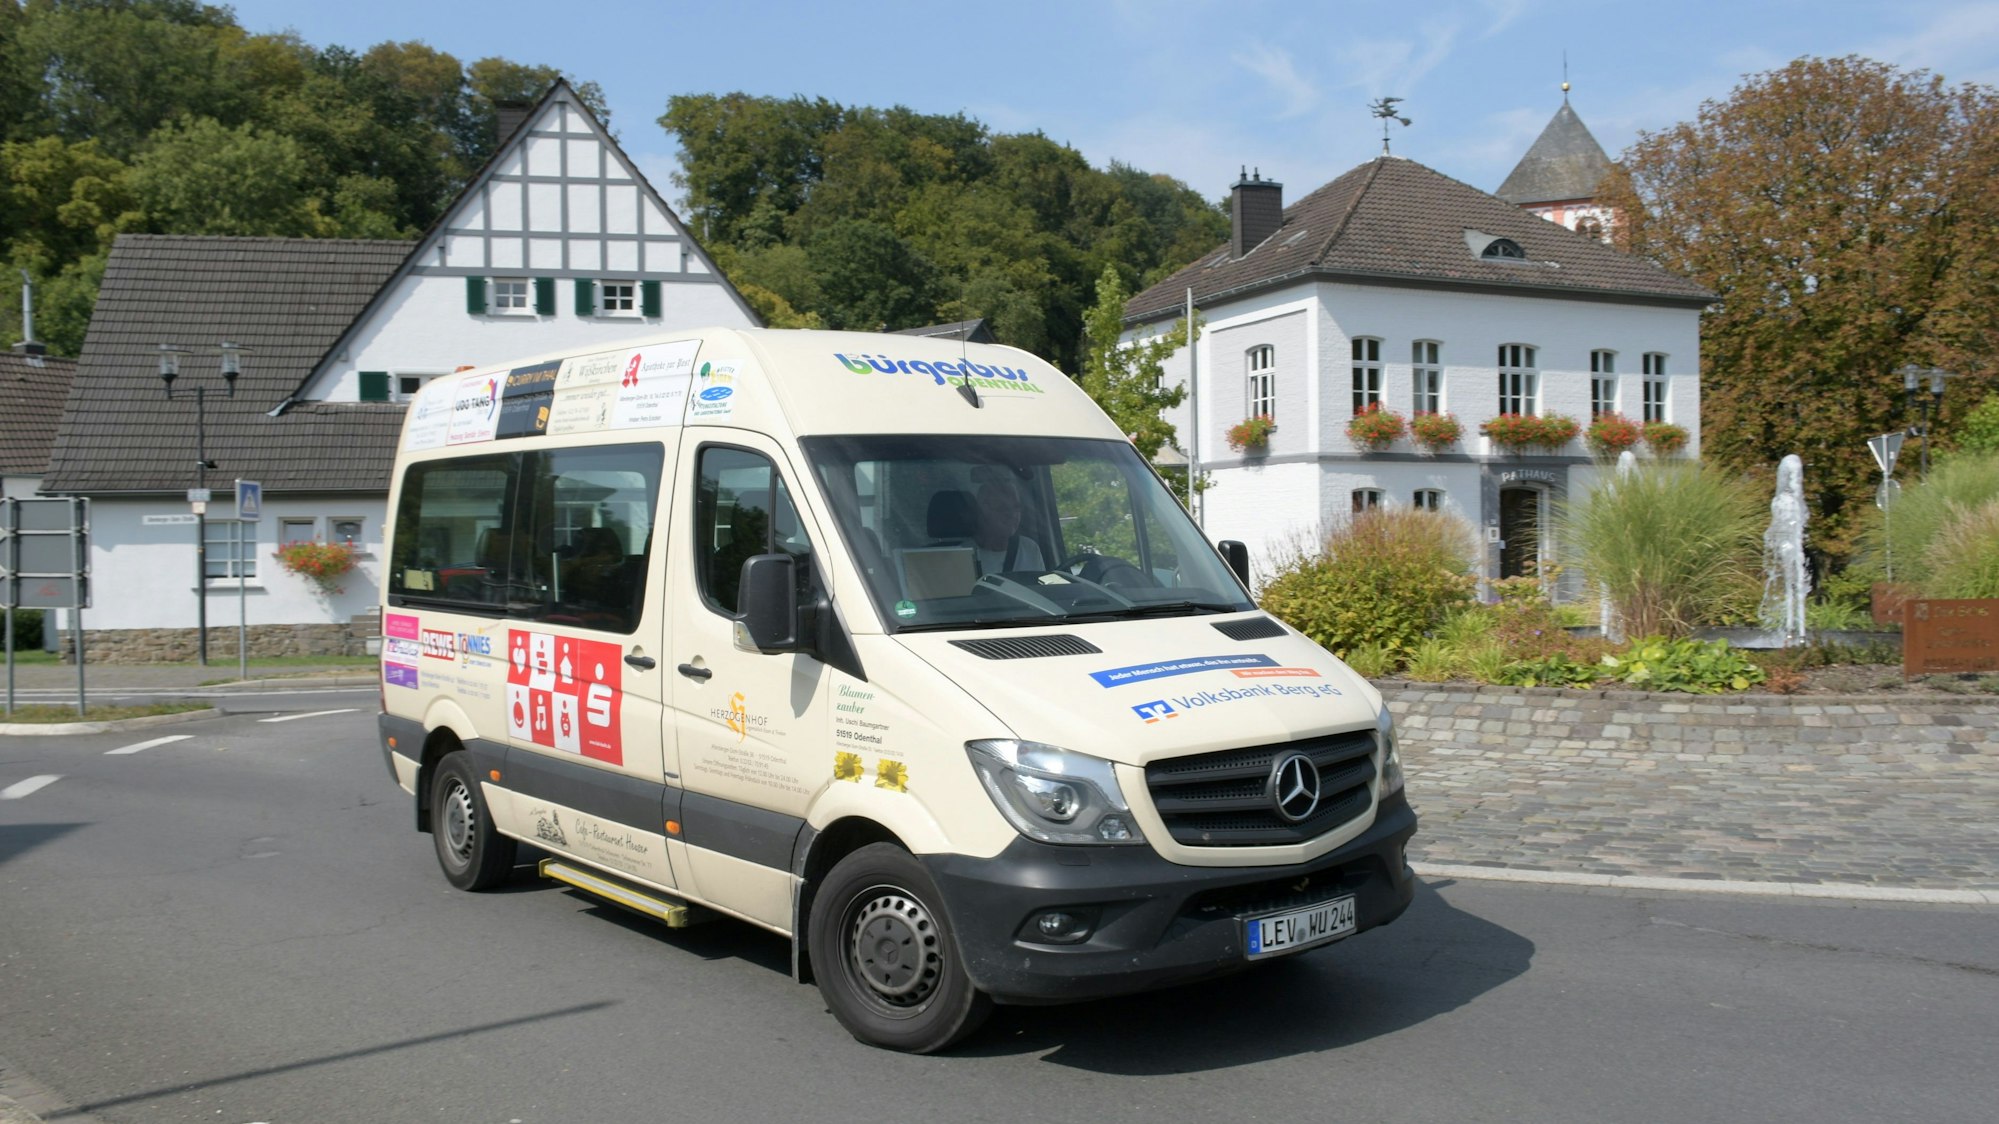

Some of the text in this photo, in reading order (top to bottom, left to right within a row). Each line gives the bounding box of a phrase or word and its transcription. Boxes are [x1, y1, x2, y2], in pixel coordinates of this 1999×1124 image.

[833, 353, 1028, 385] bürgerbus
[947, 376, 1045, 394] ODENTHAL
[456, 399, 470, 412] UDO
[471, 395, 490, 409] TANG
[422, 631, 455, 658] REWE
[1108, 672, 1132, 681] Jeder
[1131, 666, 1165, 677] Mensch
[1163, 664, 1180, 672] hat
[838, 684, 875, 700] Blumen-
[1172, 682, 1343, 709] Volksbank Berg eG
[836, 701, 865, 714] zauber
[710, 708, 768, 726] HERZOGENHOF
[836, 729, 882, 744] 51519 Odenthal
[1262, 901, 1353, 947] LEV WU 244
